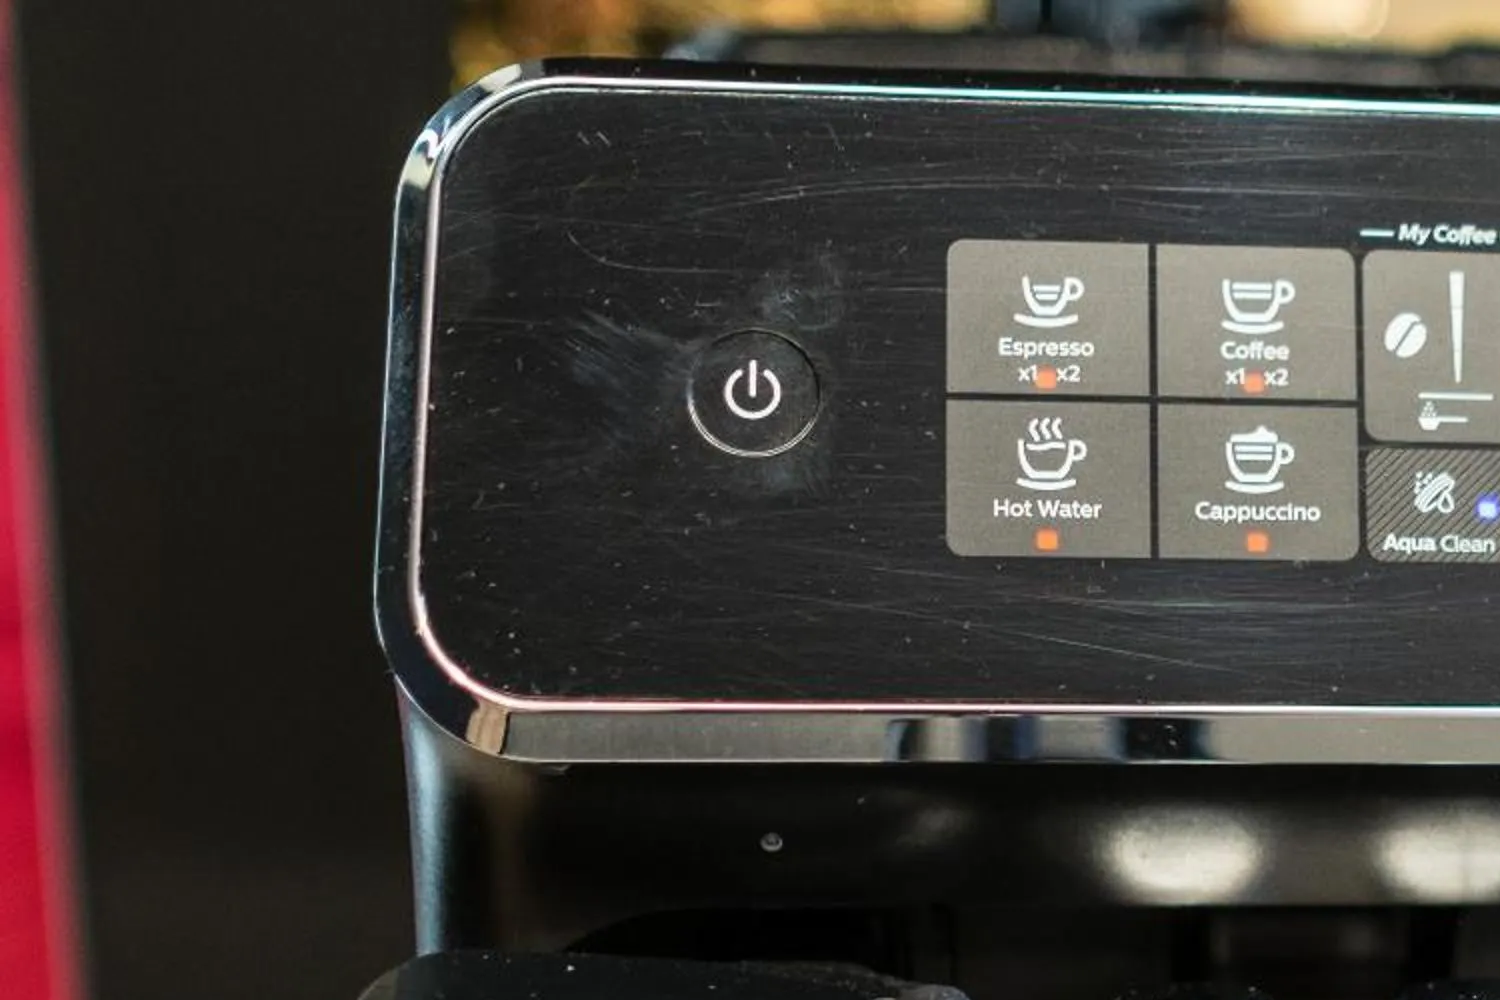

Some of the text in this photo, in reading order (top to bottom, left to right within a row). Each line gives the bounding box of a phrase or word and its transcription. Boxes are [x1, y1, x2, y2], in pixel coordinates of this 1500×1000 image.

[1398, 224, 1430, 247] My
[1434, 226, 1496, 246] Coffee
[998, 337, 1095, 358] Espresso
[1220, 341, 1290, 360] Coffee
[1056, 364, 1081, 383] x2
[1264, 368, 1289, 387] x2
[993, 499, 1102, 519] Hot Water
[1195, 502, 1321, 523] Cappuccino
[1383, 533, 1496, 554] Aqua Clean
